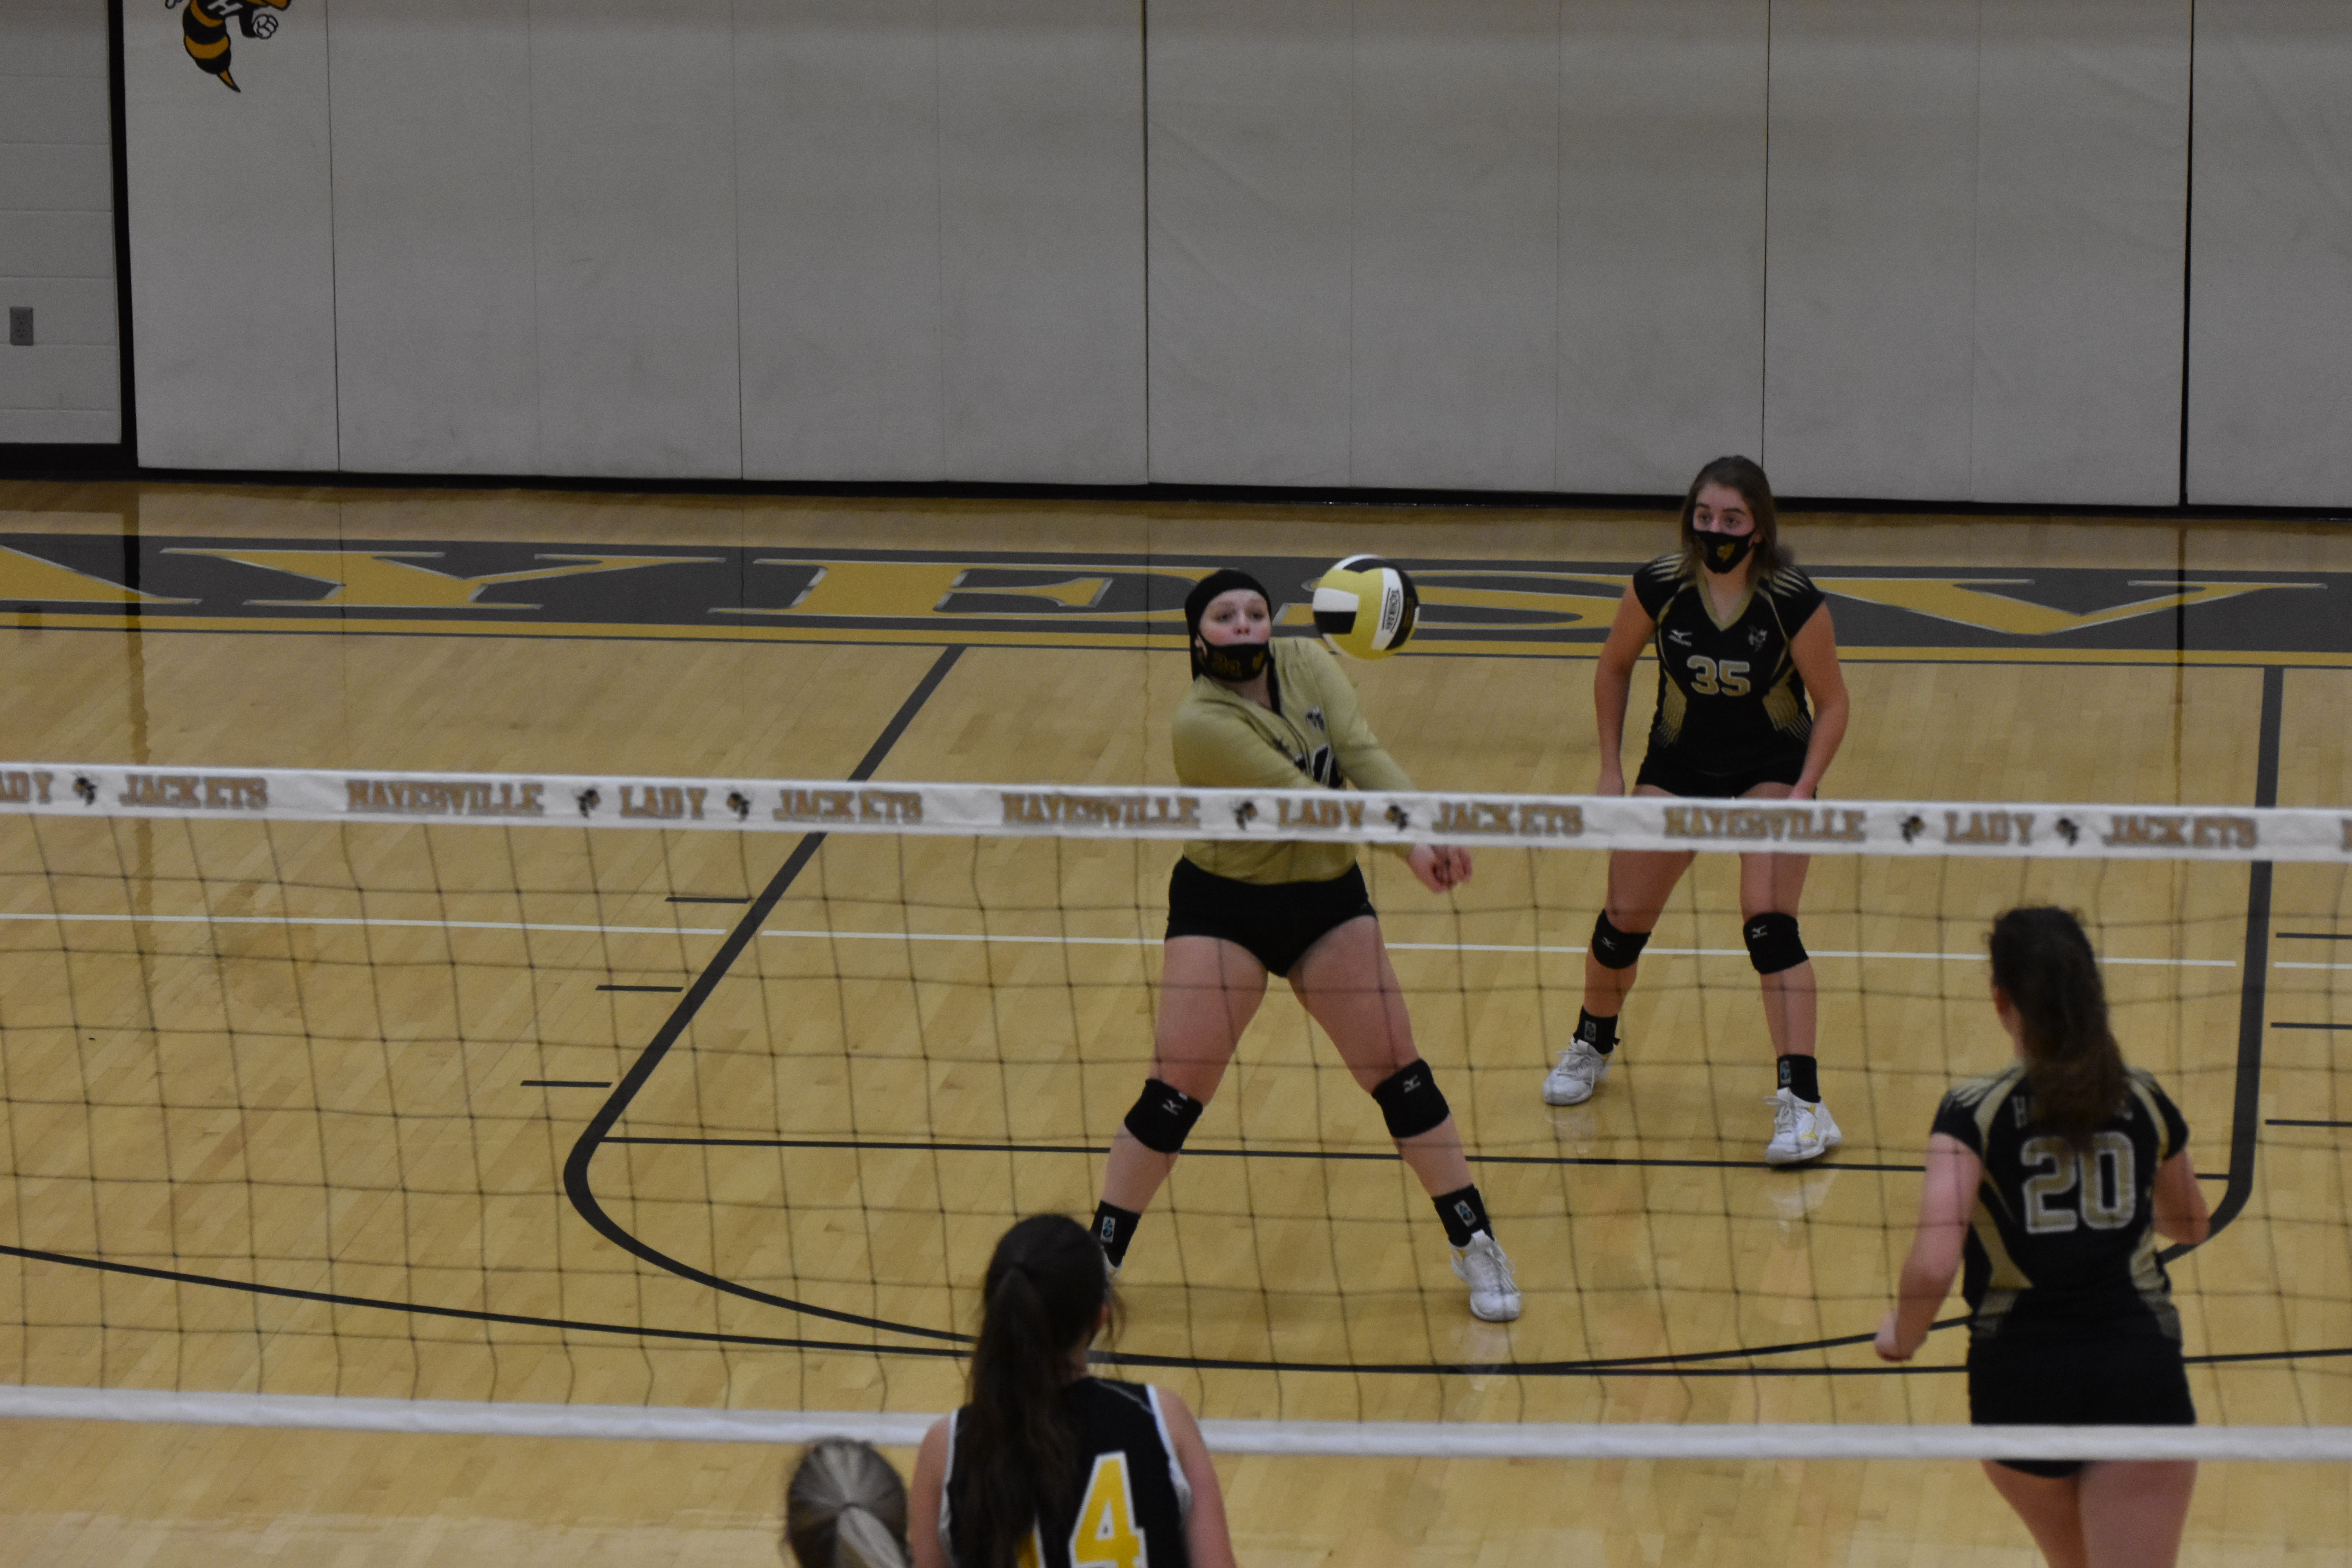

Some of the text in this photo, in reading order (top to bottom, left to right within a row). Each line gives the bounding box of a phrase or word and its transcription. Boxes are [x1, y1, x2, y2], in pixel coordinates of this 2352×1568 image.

[1687, 654, 1751, 697] 35
[0, 771, 268, 809] DY JACKETS
[345, 779, 922, 825] HAYESVILLE LADY JACKETS
[1002, 792, 1584, 838] HAYESVILLE LADY JACKETS
[1663, 805, 2258, 850] HAYESVILLE LADY JACKETS
[2021, 1131, 2136, 1234] 20
[1014, 1450, 1149, 1568] 4
